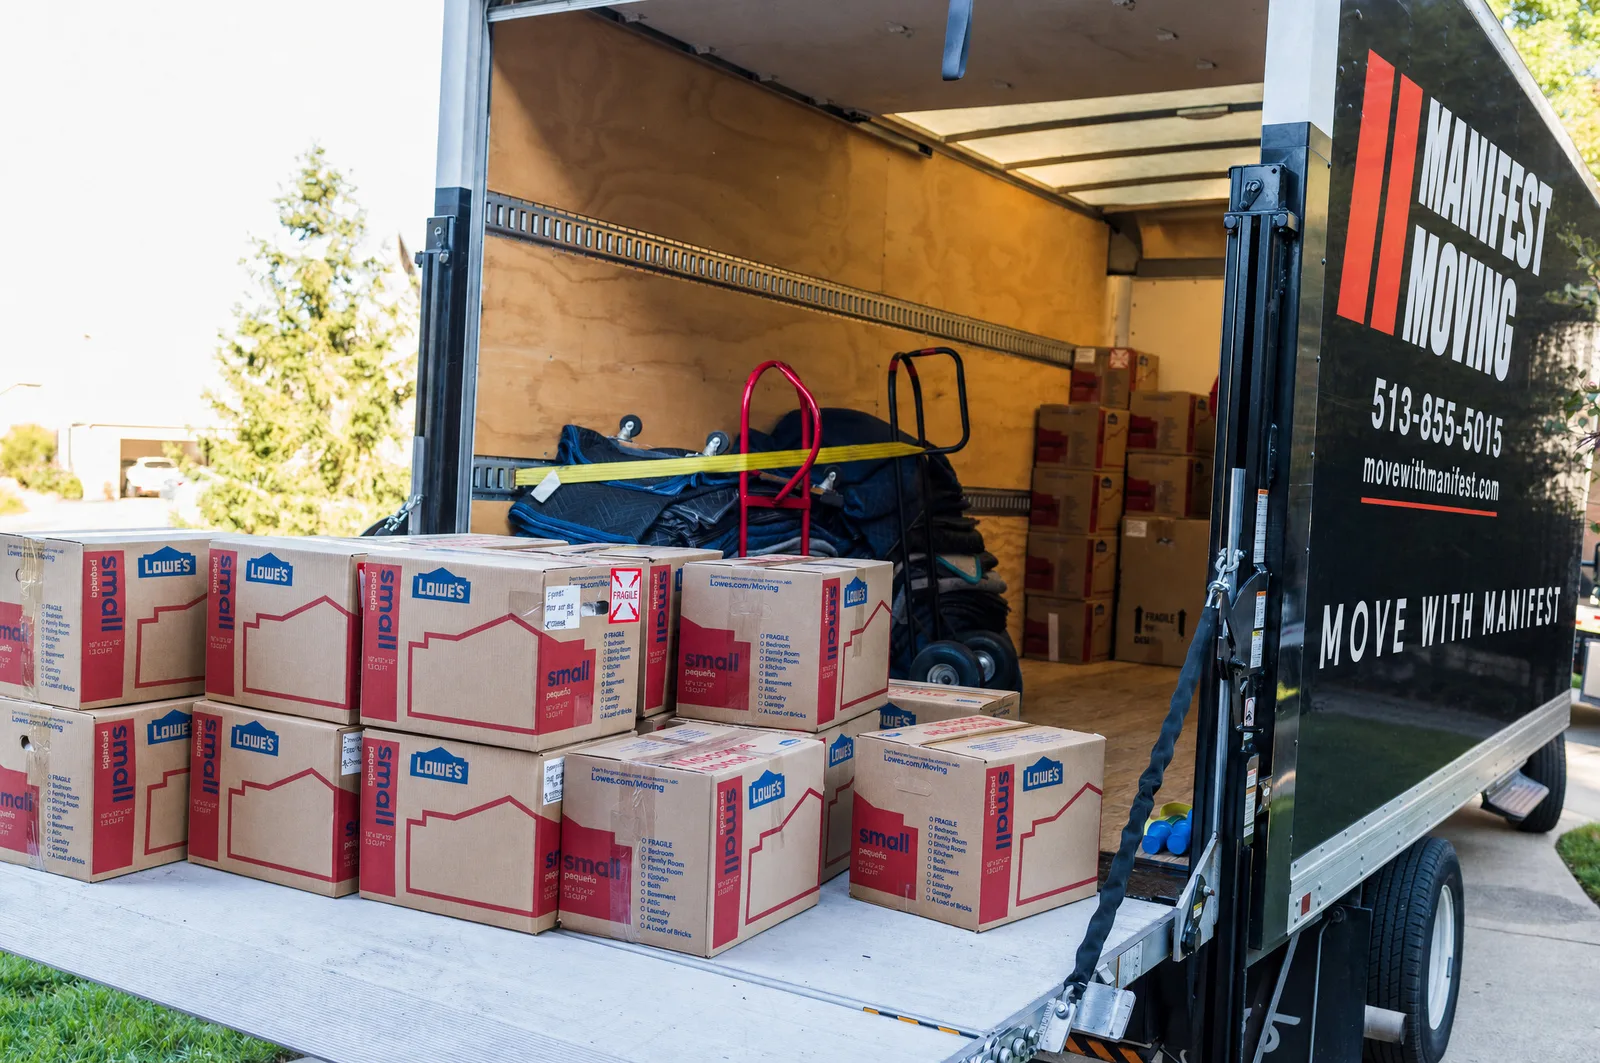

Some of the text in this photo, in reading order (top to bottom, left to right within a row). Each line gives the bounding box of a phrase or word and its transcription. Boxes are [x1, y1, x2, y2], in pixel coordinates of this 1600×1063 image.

[1418, 96, 1553, 276] MANIFEST
[1402, 224, 1517, 381] MOVING
[1371, 377, 1503, 458] 513-855-5015
[1363, 456, 1499, 501] movewithmanifest.com
[145, 557, 190, 574] LOWE'S
[251, 563, 288, 582] LOWE'S
[102, 556, 122, 632] small
[219, 554, 234, 630] small
[419, 579, 465, 599] LOWE'S
[613, 590, 637, 600] FRAGILE
[710, 579, 779, 592] Lowes.com/Moving
[378, 570, 396, 650] small
[657, 570, 667, 642] small
[0, 622, 28, 642] mall
[828, 586, 838, 660] small
[1319, 598, 1407, 669] MOVE
[1422, 593, 1474, 648] WITH
[1482, 587, 1561, 635] MANIFEST
[685, 653, 739, 672] small
[548, 660, 589, 686] small
[153, 720, 192, 740] LOWE'
[236, 730, 274, 751] LOWE'S
[113, 724, 134, 803] small
[203, 718, 218, 795] small
[884, 754, 947, 774] Lowes.com/Moving
[417, 757, 462, 779] LOWE'S
[1027, 767, 1060, 787] LOWE'S
[52, 775, 71, 783] FRAGILE
[376, 746, 394, 826] small
[591, 773, 664, 793] Lowes.com/Moving
[753, 780, 782, 803] LOWE'S
[0, 792, 32, 812] mall
[996, 771, 1012, 850] small
[725, 788, 739, 874] small
[935, 817, 957, 827] FRAGILE
[648, 839, 672, 848] FRAGILE
[860, 828, 909, 854] small
[648, 848, 674, 857] Bedroom
[648, 856, 684, 867] Family Room
[564, 855, 620, 880] small
[933, 865, 959, 876] Basement
[564, 872, 596, 884] pequeña
[932, 881, 953, 891] Laundry
[647, 890, 676, 901] Basement
[647, 907, 670, 917] Laundry
[956, 903, 972, 912] Bricks
[647, 915, 668, 925] Garage
[674, 929, 692, 938] Bricks
